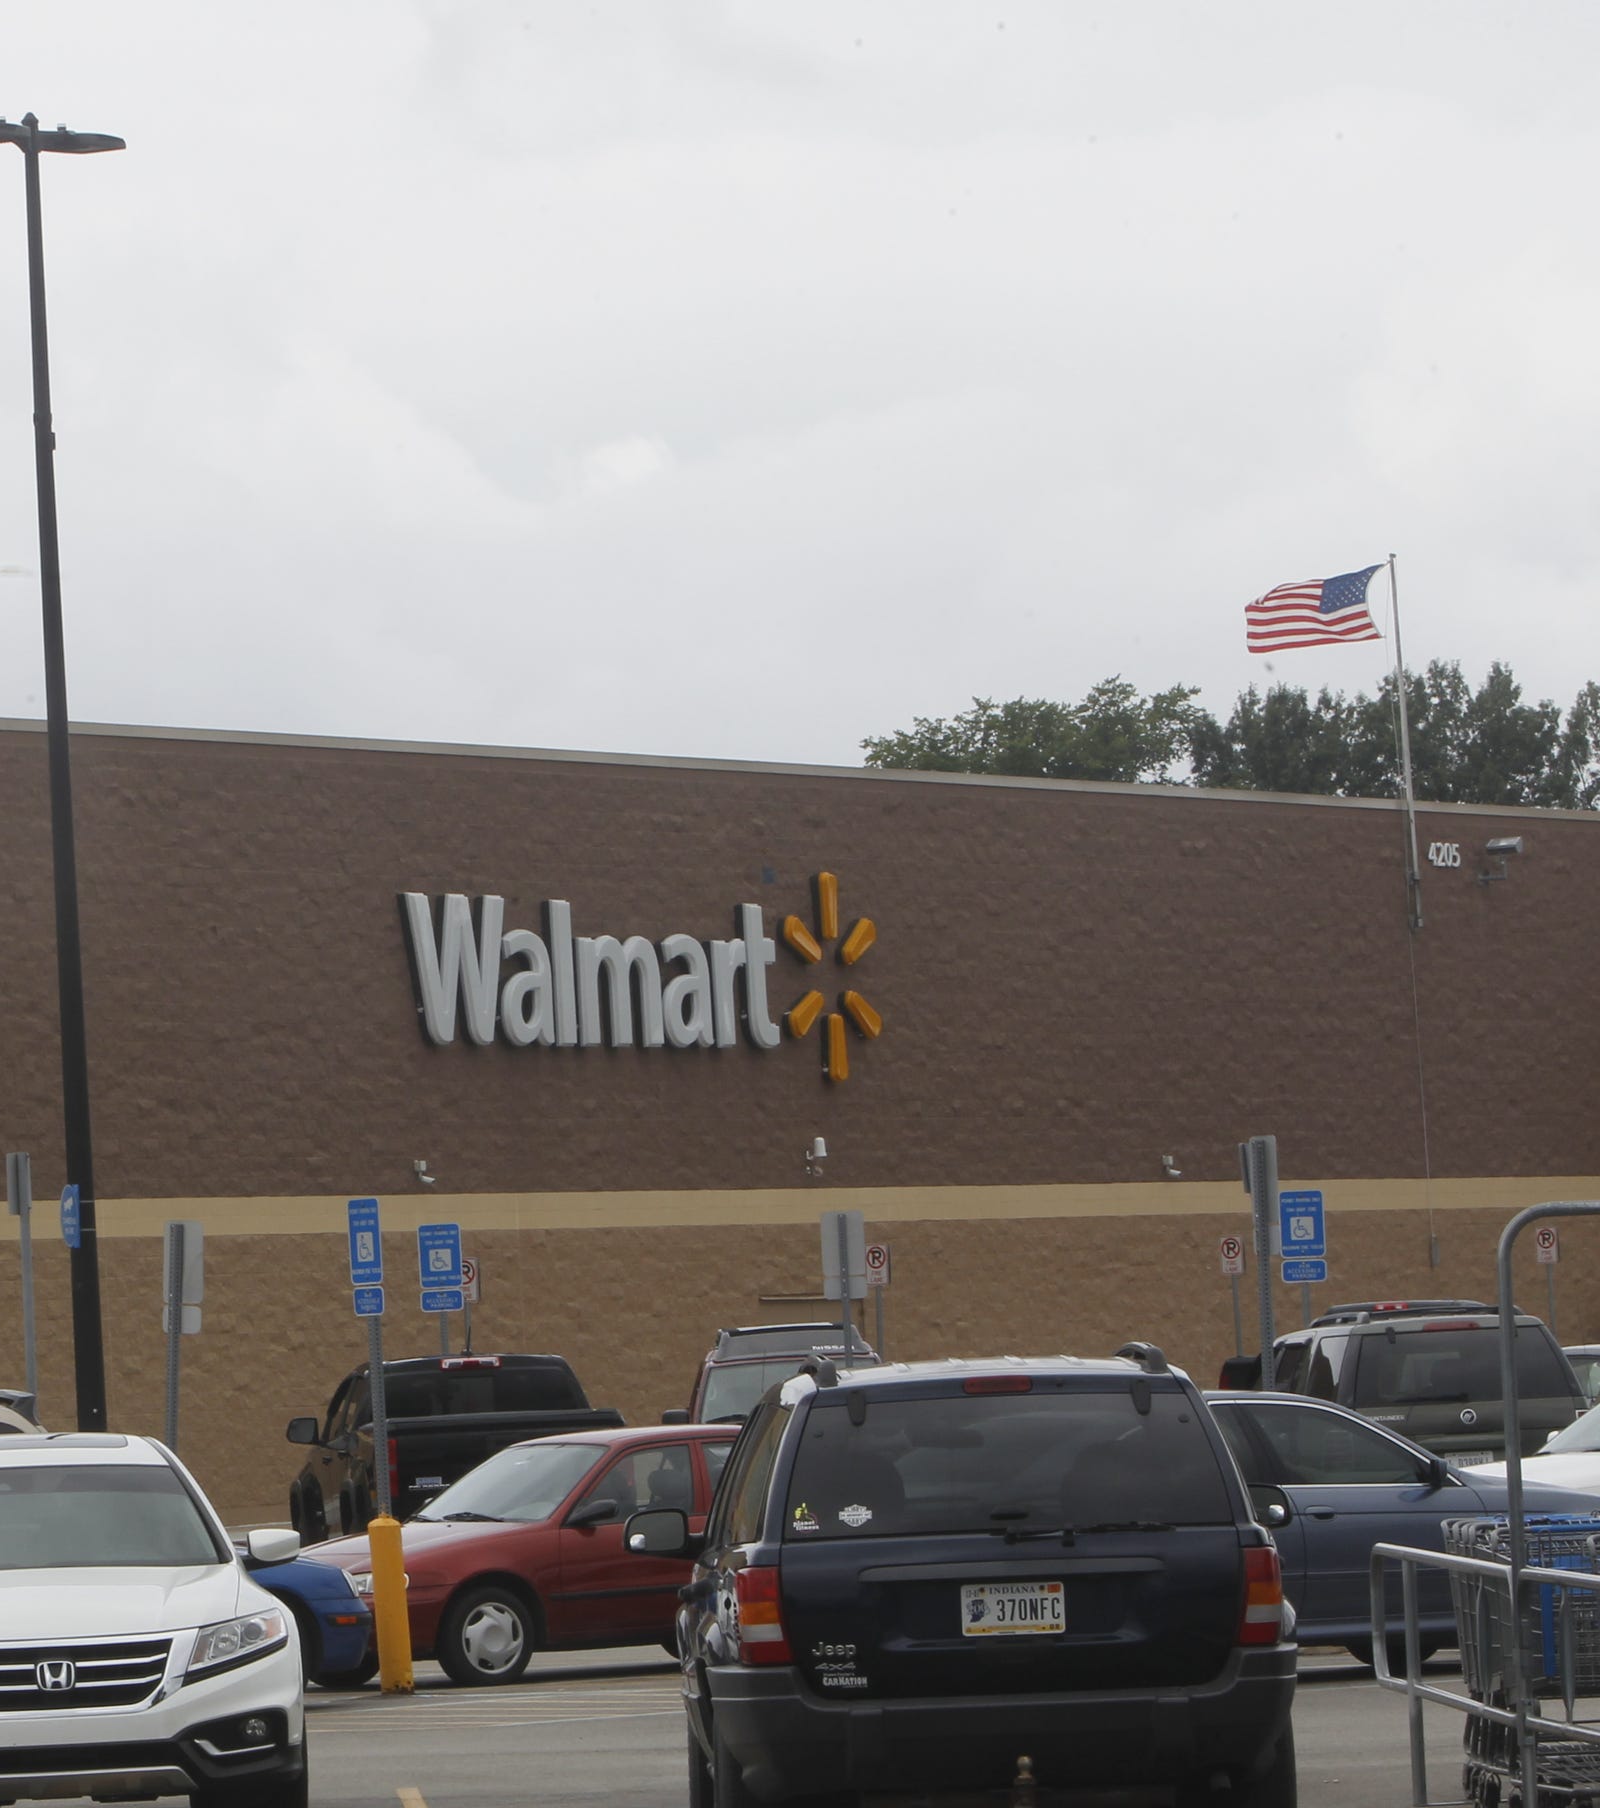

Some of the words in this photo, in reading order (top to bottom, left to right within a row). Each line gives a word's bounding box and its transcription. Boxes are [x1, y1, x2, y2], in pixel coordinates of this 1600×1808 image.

[1429, 842, 1461, 867] 4205
[403, 891, 781, 1048] Walmart
[989, 1585, 1036, 1594] INDIANA
[996, 1597, 1061, 1622] 370NFC
[812, 1641, 856, 1658] Jeep
